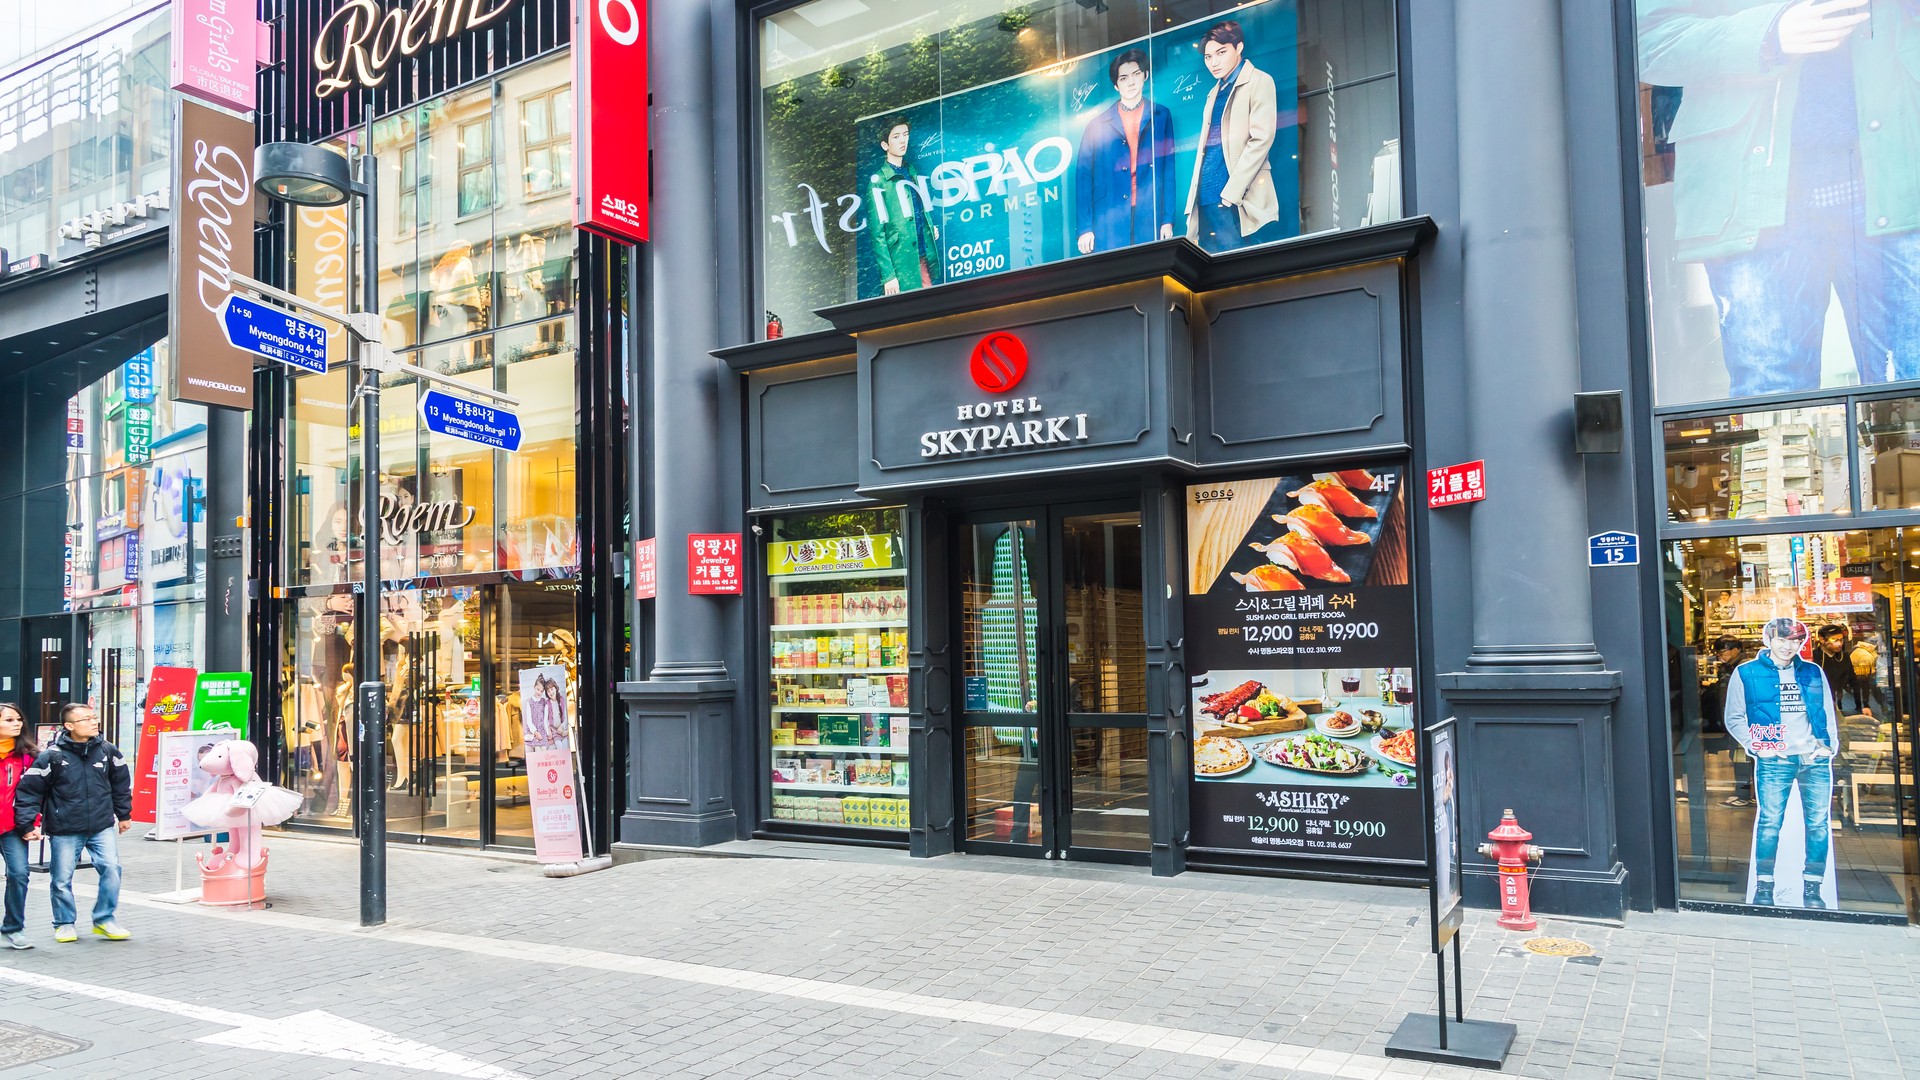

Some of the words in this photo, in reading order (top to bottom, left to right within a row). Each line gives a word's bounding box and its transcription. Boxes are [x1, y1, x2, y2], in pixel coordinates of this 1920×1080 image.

[189, 65, 220, 81] GLOBAL
[232, 80, 250, 93] FREE
[197, 75, 244, 101] 市区退税
[1183, 94, 1195, 102] KAI
[917, 151, 932, 160] CHAN
[931, 136, 1074, 208] SPAO
[601, 193, 639, 219] 스파오
[944, 203, 993, 224] FOR
[1004, 186, 1060, 214] MEN
[187, 139, 251, 314] Roem
[601, 208, 640, 228] WWW.SPAO.COM
[948, 239, 994, 262] COAT
[947, 254, 1005, 279] 129,900
[243, 308, 253, 319] 50
[249, 324, 305, 354] Myeongdong
[305, 344, 325, 359] 4-gil
[285, 318, 325, 347] 명동4길
[187, 376, 247, 395] WWW.ROEM.COM
[429, 404, 439, 417] 13
[454, 400, 496, 424] 명동8나길
[957, 397, 1042, 421] HOTEL
[442, 412, 484, 431] Myeongdong
[484, 423, 506, 437] 8na-gil
[508, 426, 517, 437] 17
[920, 416, 1071, 458] SKYPARK
[1368, 473, 1396, 493] 4F
[1431, 468, 1481, 495] 커플링
[359, 492, 476, 546] Roem
[693, 539, 737, 556] 영광사
[1603, 548, 1625, 562] 15
[700, 556, 730, 565] Jewelry
[794, 565, 820, 573] KOREAN
[821, 563, 834, 571] RED
[835, 562, 864, 570] GINSENG
[695, 565, 736, 578] 커플링
[1234, 595, 1297, 613] 스시&그릴
[1298, 594, 1325, 612] 뷔페
[1328, 592, 1357, 610] 수사
[1264, 613, 1280, 621] AND
[1280, 612, 1298, 620] GRILL
[1297, 612, 1321, 620] BUFFET
[1321, 611, 1346, 619] SOOSA
[1217, 627, 1229, 635] 평일
[1228, 627, 1240, 635] 런치
[1242, 624, 1293, 643] 12,900
[1326, 621, 1379, 641] 19,900
[1299, 632, 1316, 641] 공휴일
[1247, 647, 1260, 655] 수사
[1260, 646, 1294, 655] 명동스파오점
[1378, 673, 1405, 692] 5F
[1748, 723, 1788, 740] 你好
[1751, 742, 1787, 751] SPAO
[1265, 790, 1340, 810] ASHLEY
[1222, 814, 1234, 823] 평일
[1234, 815, 1245, 823] 런치
[1247, 815, 1299, 834] 12,900
[1333, 819, 1386, 839] 19,900
[1305, 826, 1323, 835] 공휴일
[1251, 836, 1269, 845] 애슐리
[1269, 837, 1304, 847] 명동스파오점
[1505, 876, 1518, 906] 소화전
